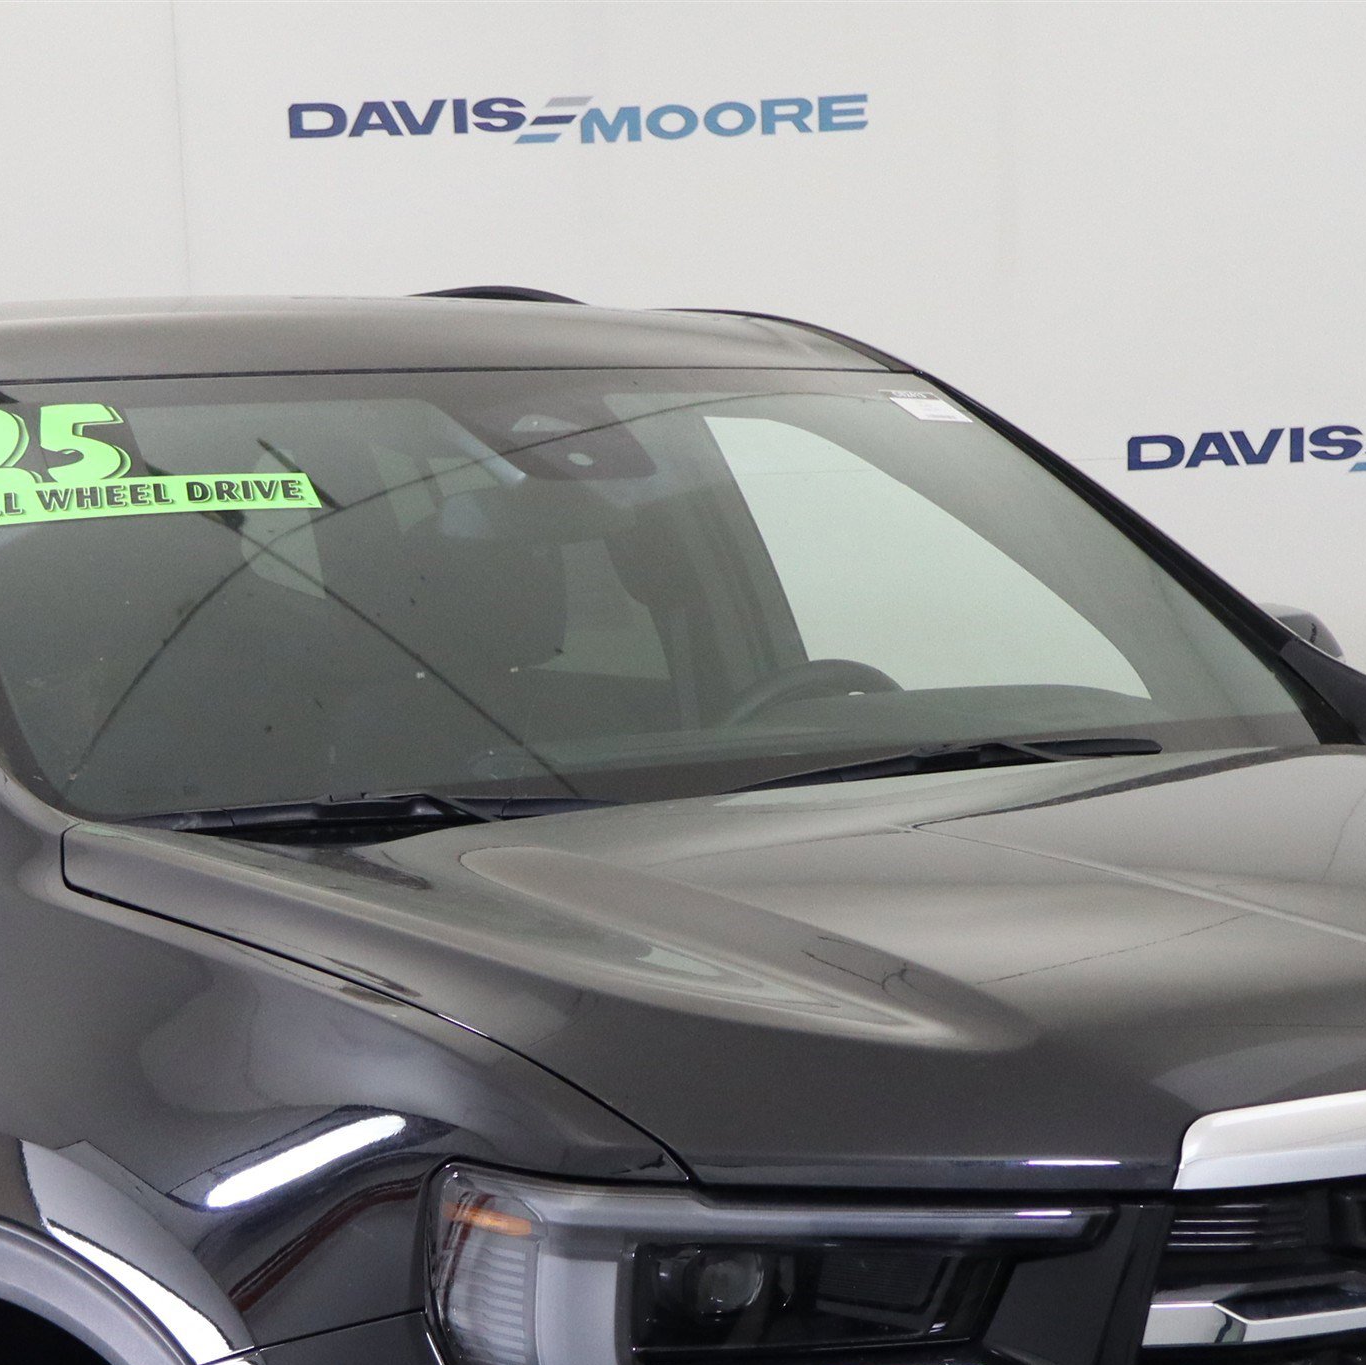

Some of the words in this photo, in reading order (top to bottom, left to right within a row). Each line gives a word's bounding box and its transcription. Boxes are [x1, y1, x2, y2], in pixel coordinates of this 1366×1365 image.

[287, 96, 527, 139] DAVIS
[579, 93, 869, 144] MOORE
[1126, 424, 1364, 472] DAVIS
[35, 482, 172, 512] WHEEL
[186, 478, 304, 505] DRIVE
